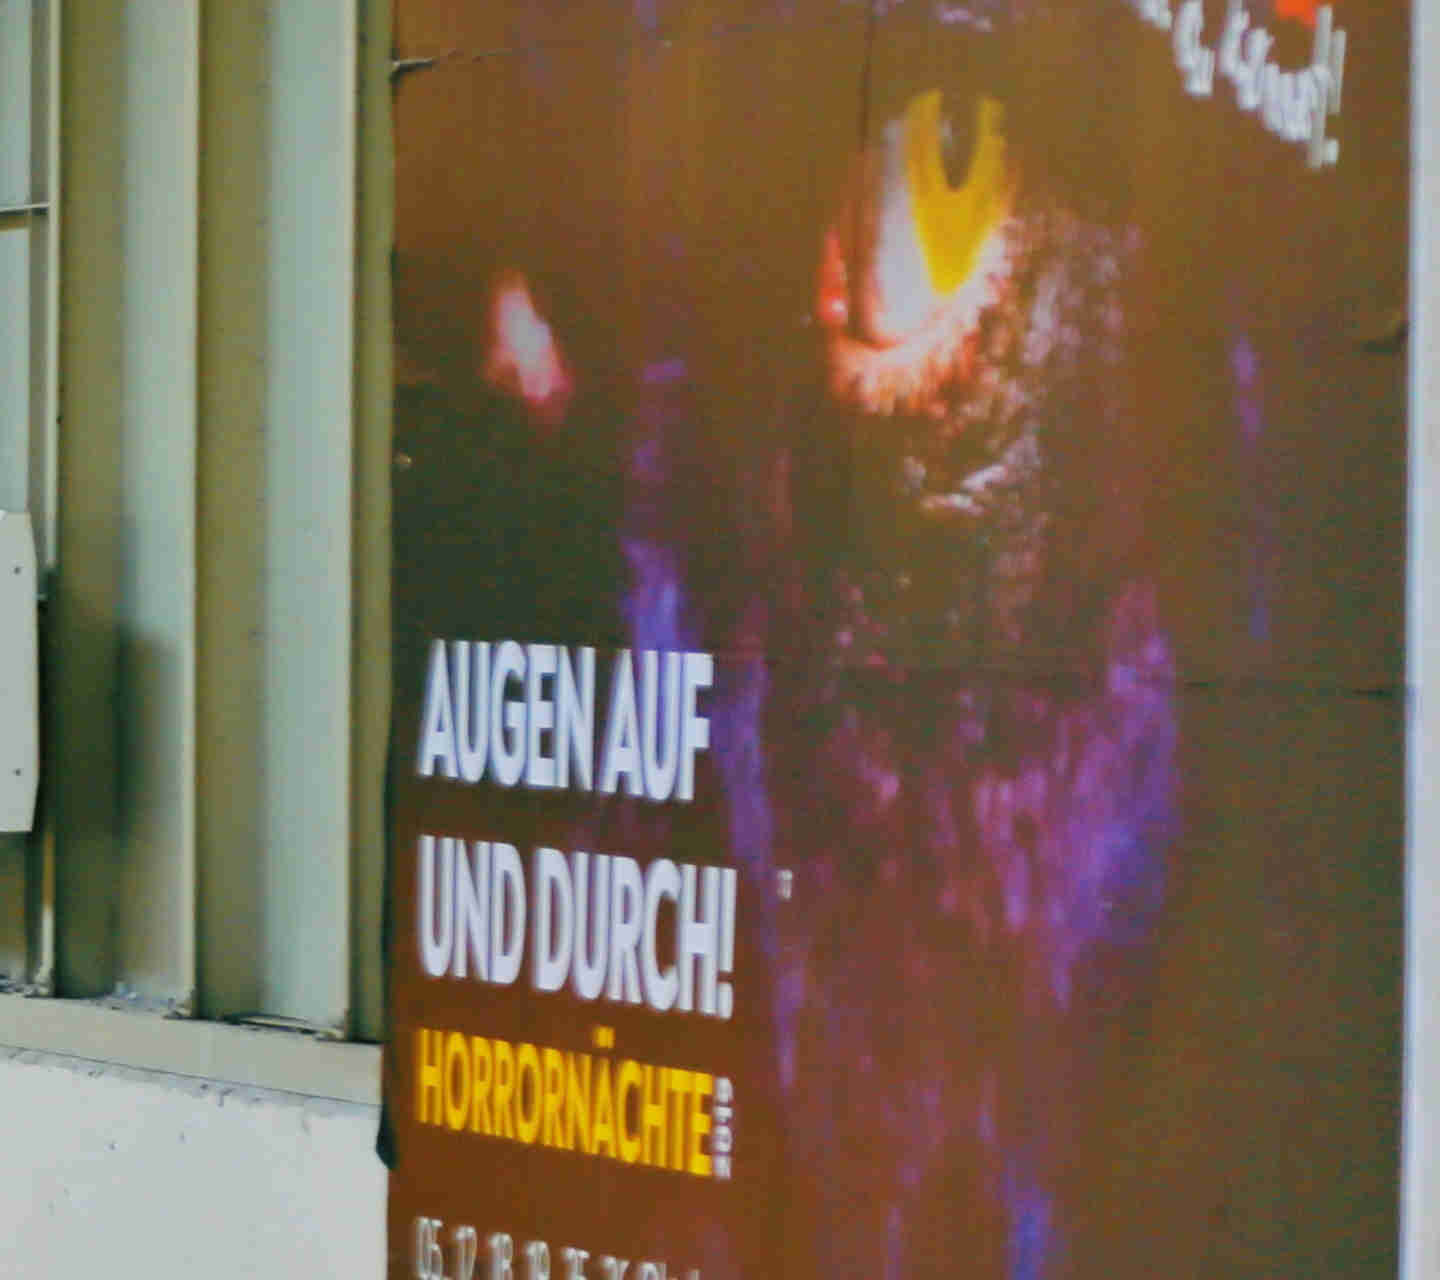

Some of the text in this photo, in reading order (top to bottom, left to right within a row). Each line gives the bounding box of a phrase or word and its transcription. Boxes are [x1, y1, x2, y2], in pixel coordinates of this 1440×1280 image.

[418, 638, 714, 802] AUGEN AUF
[417, 834, 738, 1020] UND DURCH!
[418, 1025, 713, 1178] HORRORNÄCHTE
